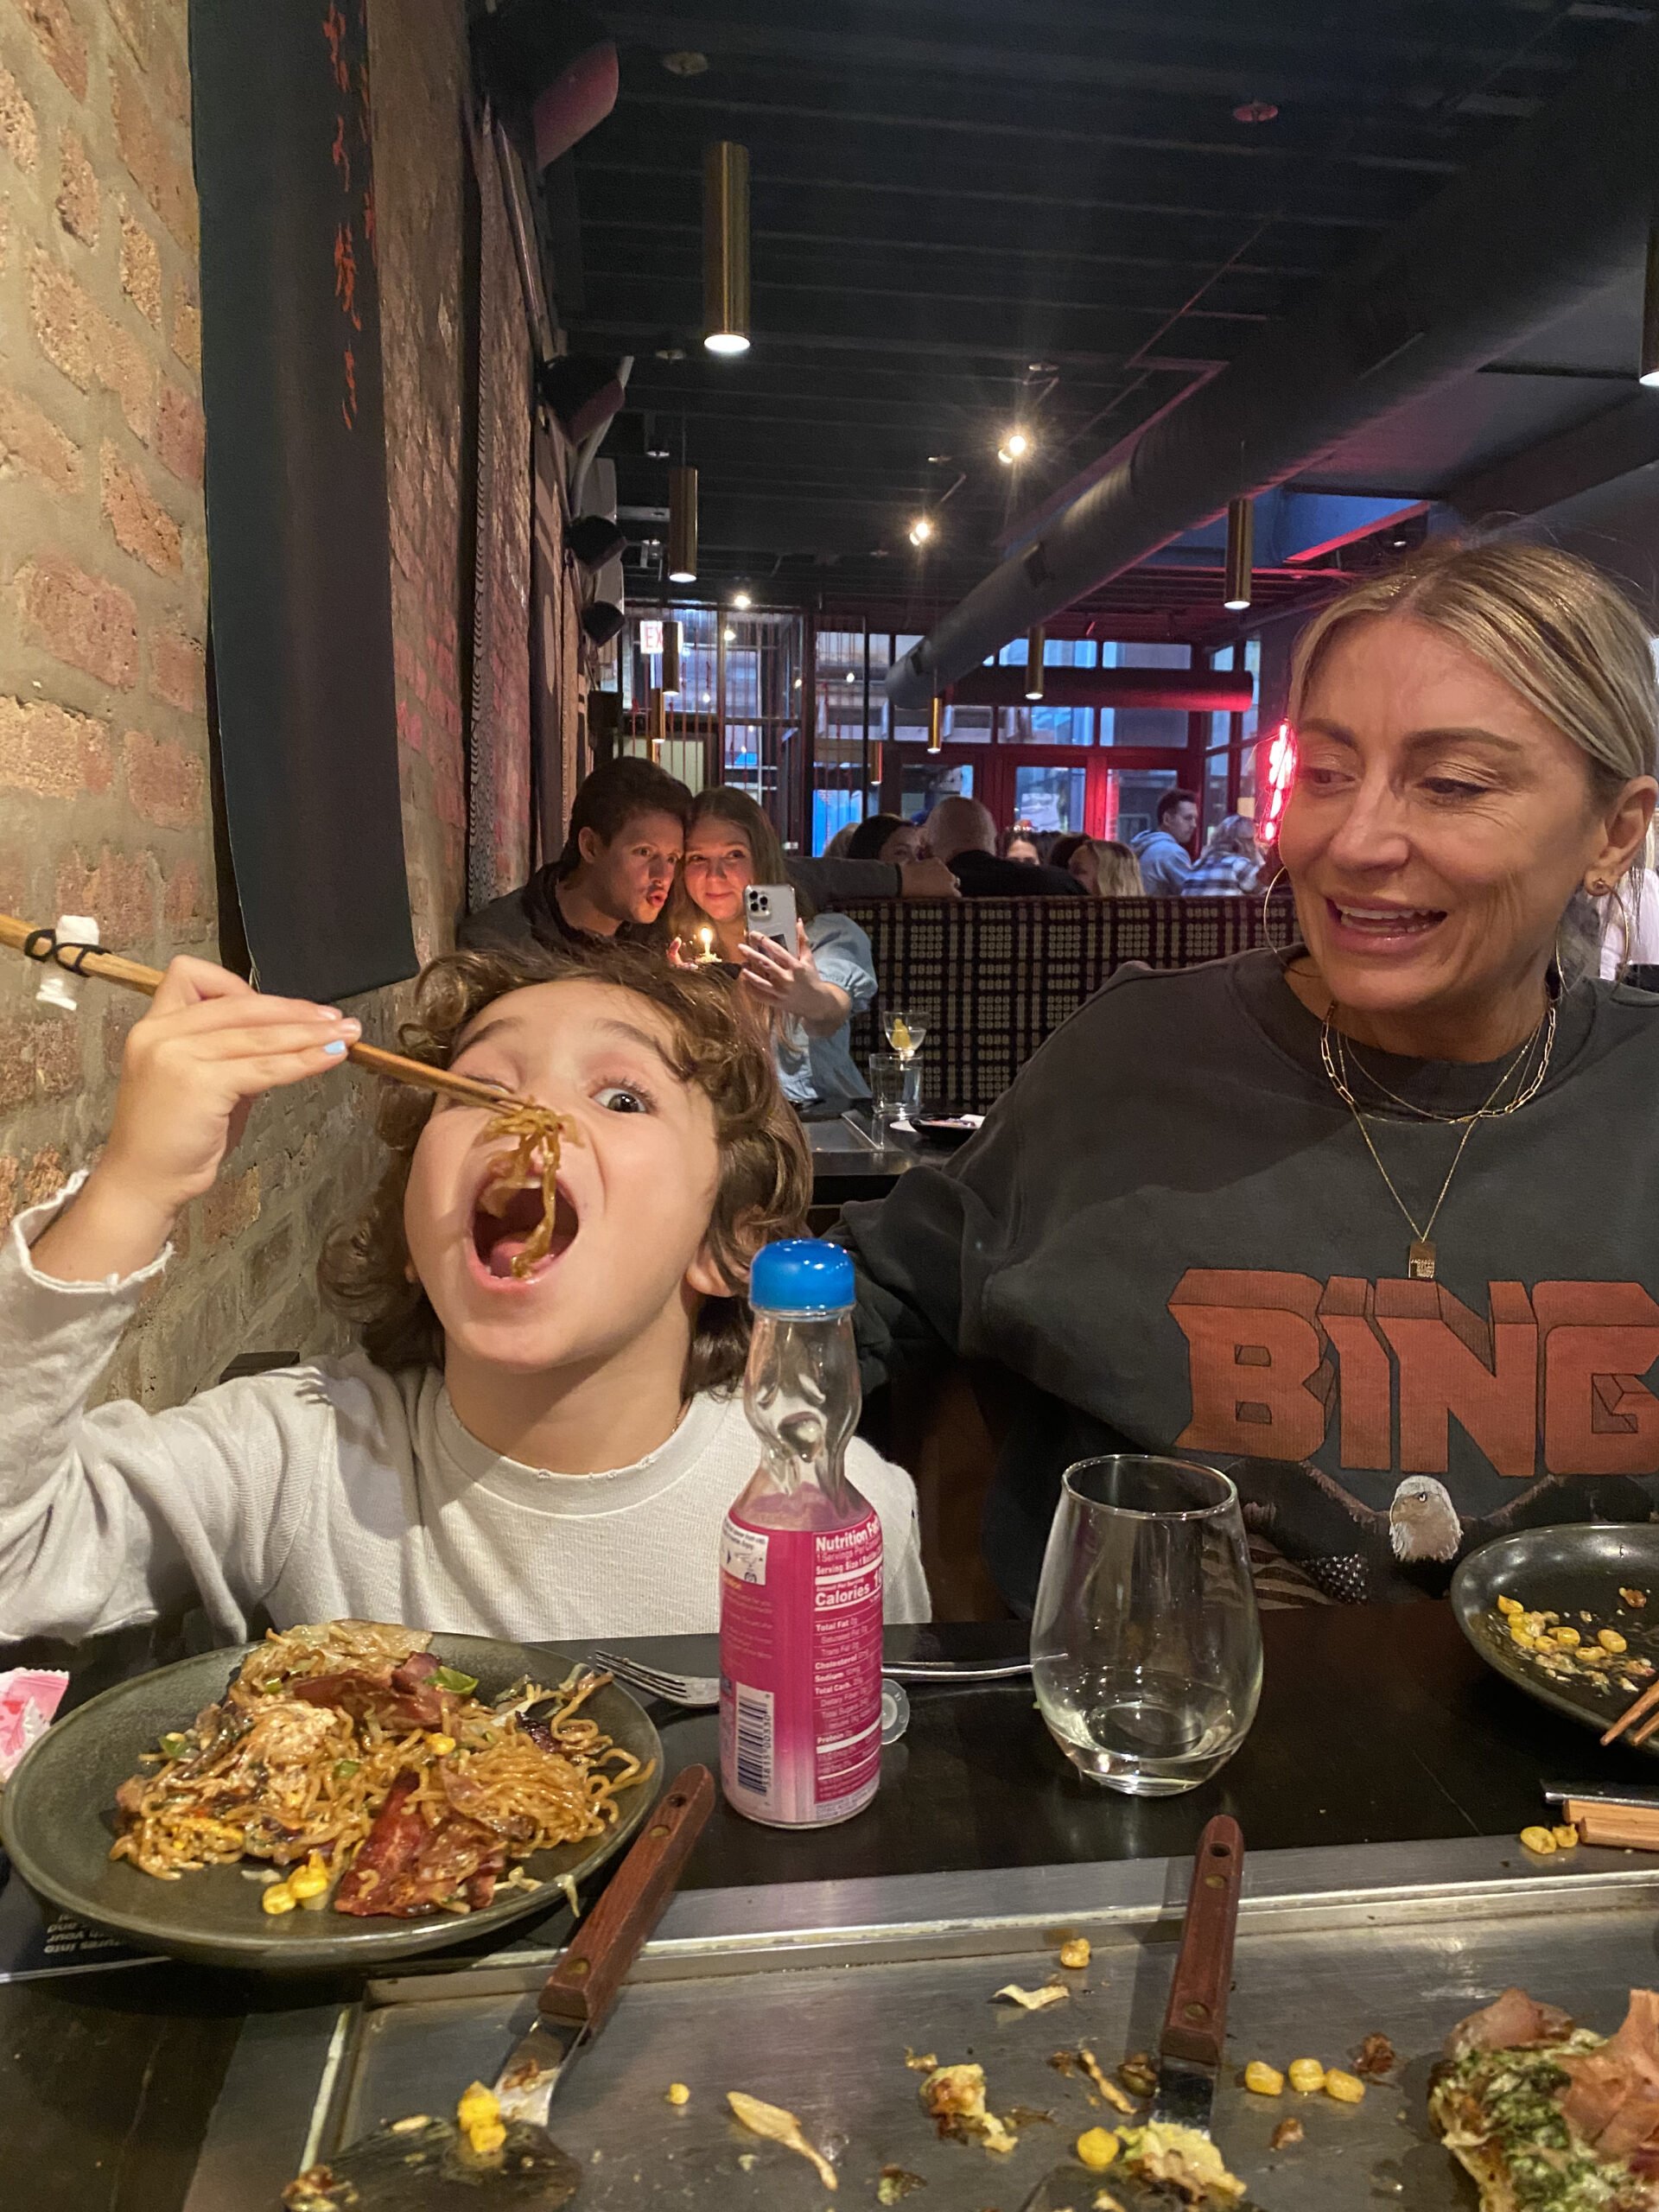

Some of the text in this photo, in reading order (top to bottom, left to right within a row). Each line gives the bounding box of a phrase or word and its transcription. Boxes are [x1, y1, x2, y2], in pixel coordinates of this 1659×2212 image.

[645, 626, 663, 648] EX
[1167, 1268, 1659, 1477] BING
[816, 1529, 868, 1552] Nutrition
[815, 1583, 870, 1606] Calories
[816, 1623, 836, 1632] Total
[837, 1619, 849, 1629] Fat
[815, 1672, 844, 1683] Sodium
[815, 1686, 833, 1695] Total
